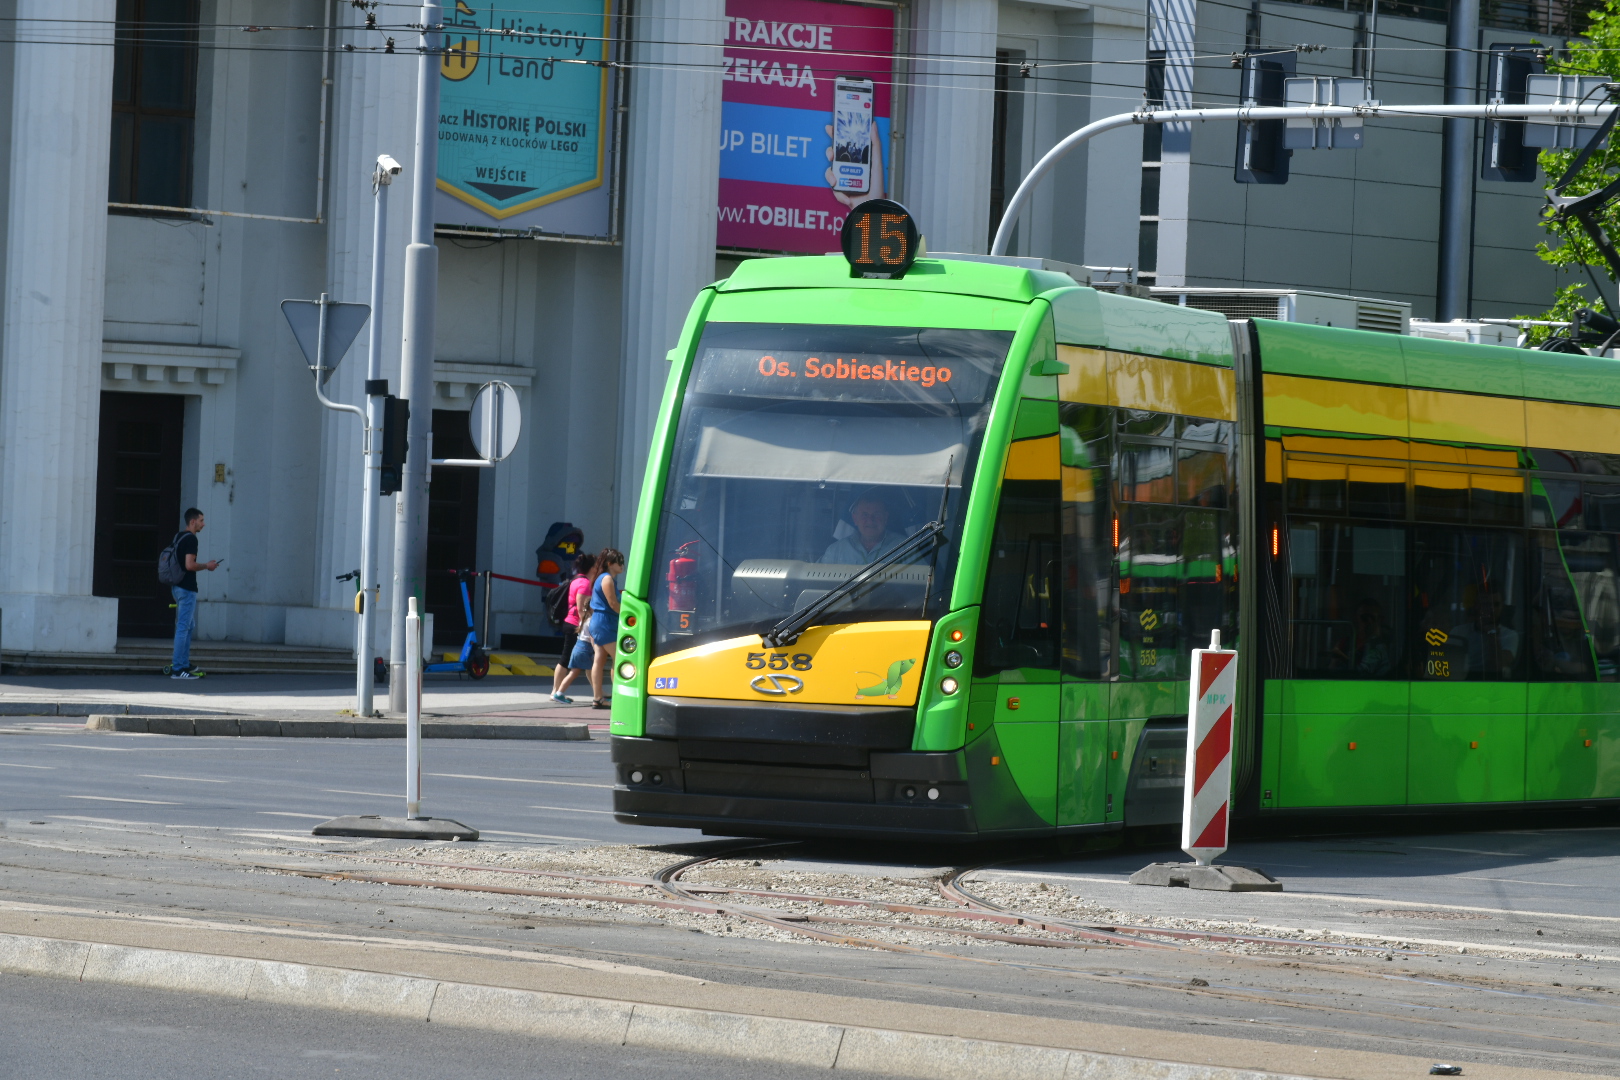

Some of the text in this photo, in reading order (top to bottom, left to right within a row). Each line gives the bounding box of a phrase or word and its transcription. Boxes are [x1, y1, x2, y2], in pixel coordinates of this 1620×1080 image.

[501, 18, 586, 57] History
[499, 52, 554, 80] Land
[500, 137, 548, 150] KLOCKÓW
[751, 132, 812, 158] BILET
[475, 166, 527, 182] WEJŚCIE
[855, 213, 908, 265] 15
[758, 355, 952, 388] Os. Sobieskiego
[680, 613, 690, 629] 5
[745, 652, 813, 671] 558
[1140, 649, 1156, 666] 558
[1206, 693, 1227, 705] MPK
